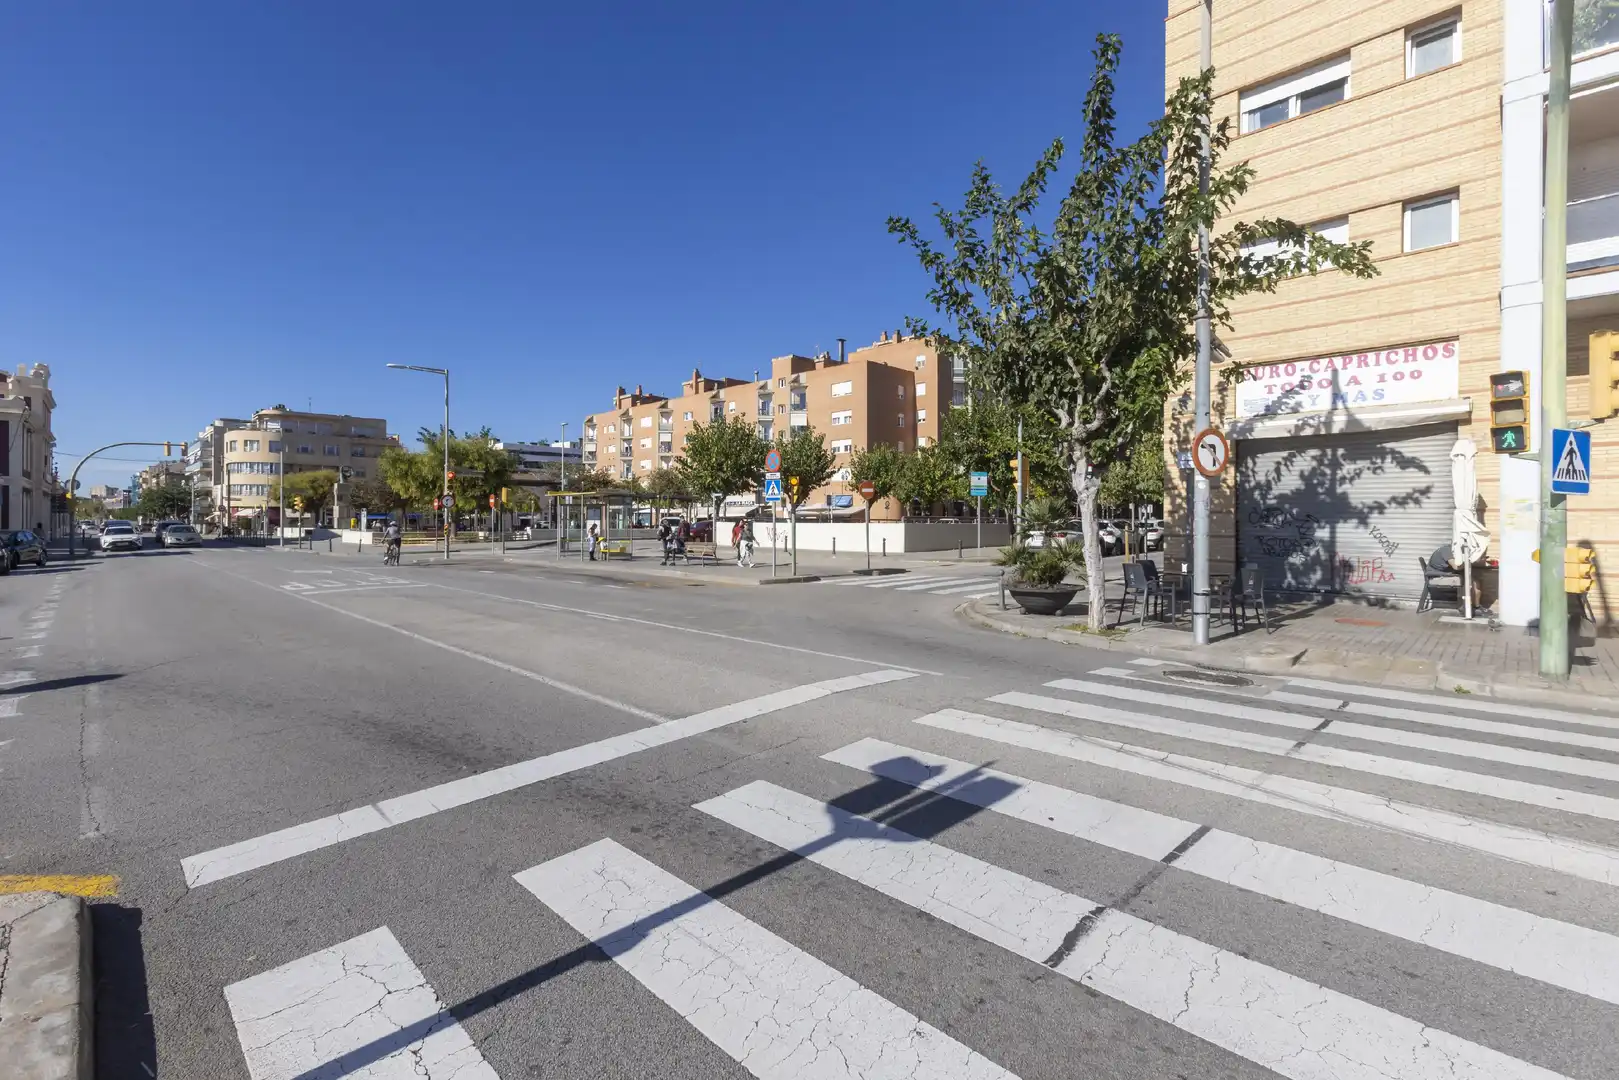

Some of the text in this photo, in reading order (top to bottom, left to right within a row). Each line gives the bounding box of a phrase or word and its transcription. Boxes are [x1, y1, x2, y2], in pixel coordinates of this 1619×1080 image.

[1344, 375, 1363, 387] A
[1376, 369, 1423, 384] 100
[1308, 394, 1321, 407] Y
